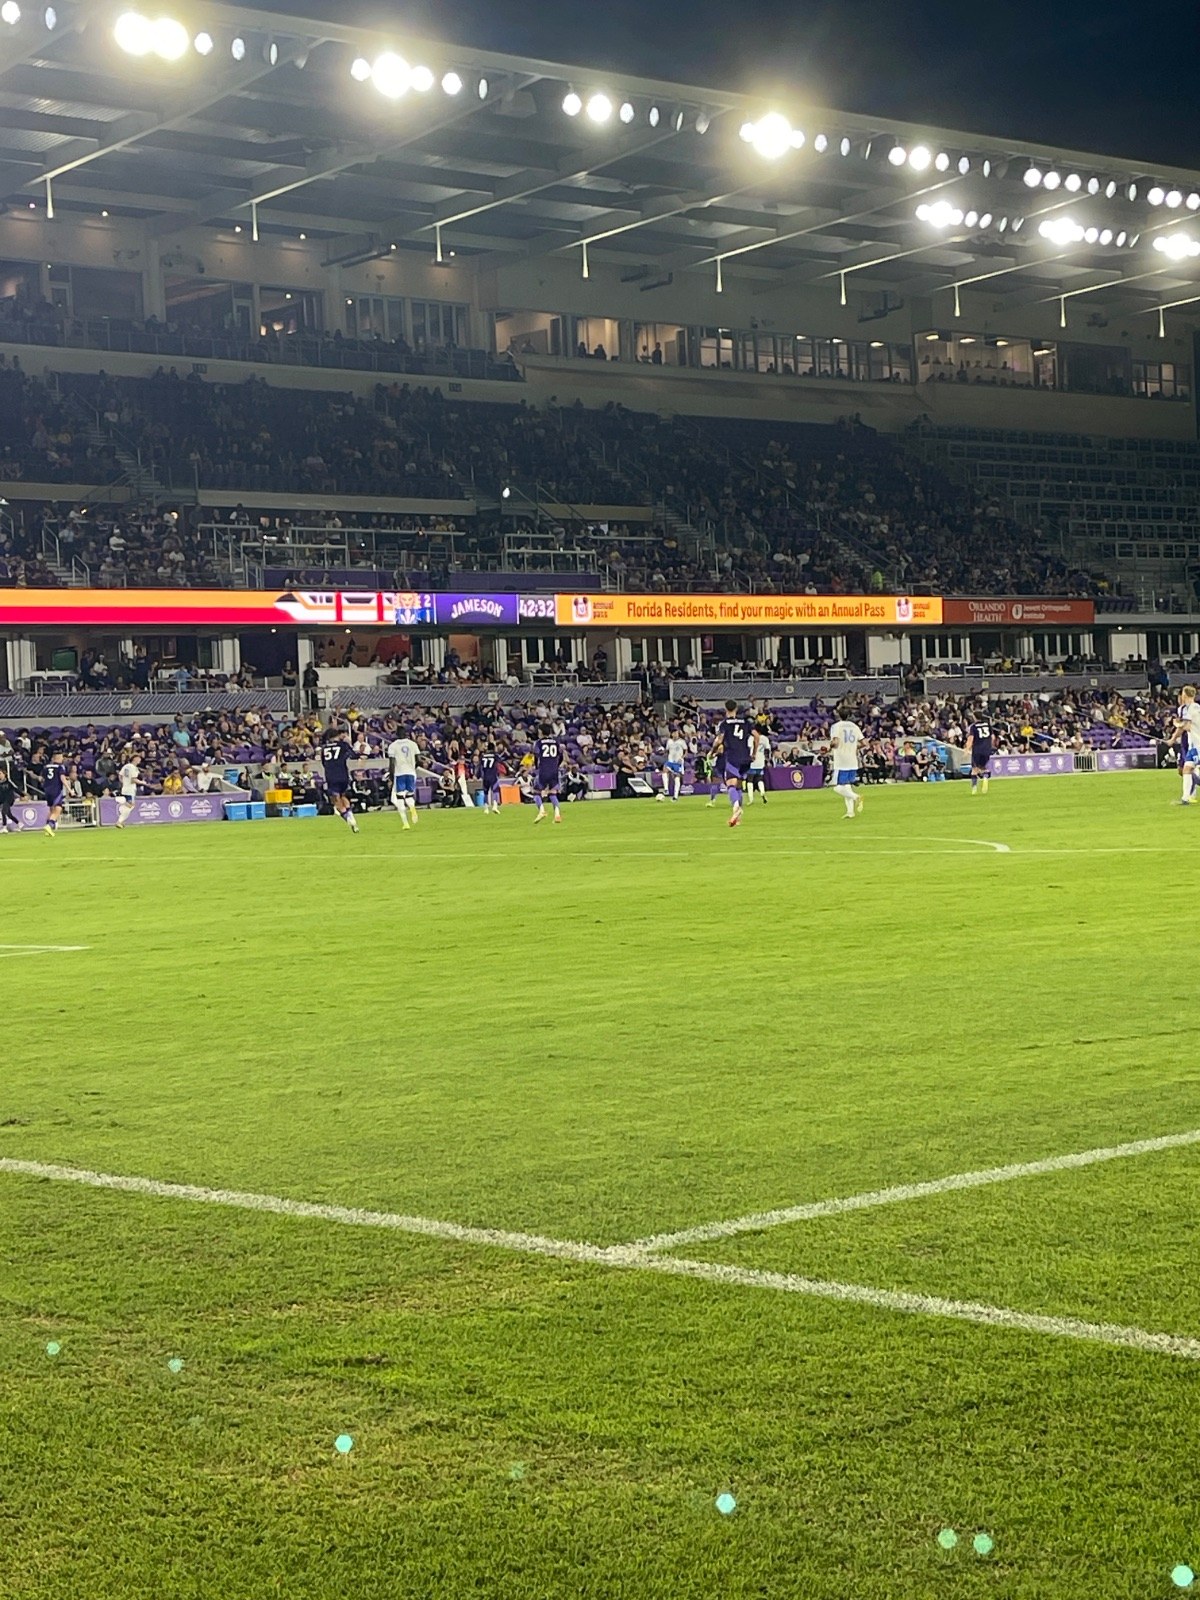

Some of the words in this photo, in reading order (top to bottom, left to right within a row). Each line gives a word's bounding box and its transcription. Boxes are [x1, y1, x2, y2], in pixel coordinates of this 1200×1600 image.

[424, 594, 431, 607] 2
[968, 601, 1006, 611] ORLANDO
[451, 598, 504, 619] JAMESON
[519, 600, 554, 617] 42:32
[627, 602, 662, 618] Florida
[665, 602, 717, 619] Residents,
[720, 602, 739, 618] find
[741, 606, 762, 620] your
[765, 602, 793, 620] magic
[796, 603, 816, 618] with
[818, 607, 829, 617] an
[832, 603, 862, 617] Annual
[864, 603, 885, 617] Pass
[973, 612, 1002, 622] HEALTH
[733, 724, 744, 740] 4
[843, 728, 856, 744] 16
[323, 746, 341, 761] 57
[401, 746, 409, 758] 9
[541, 744, 557, 757] 20
[482, 757, 495, 768] 77
[47, 768, 54, 779] 3
